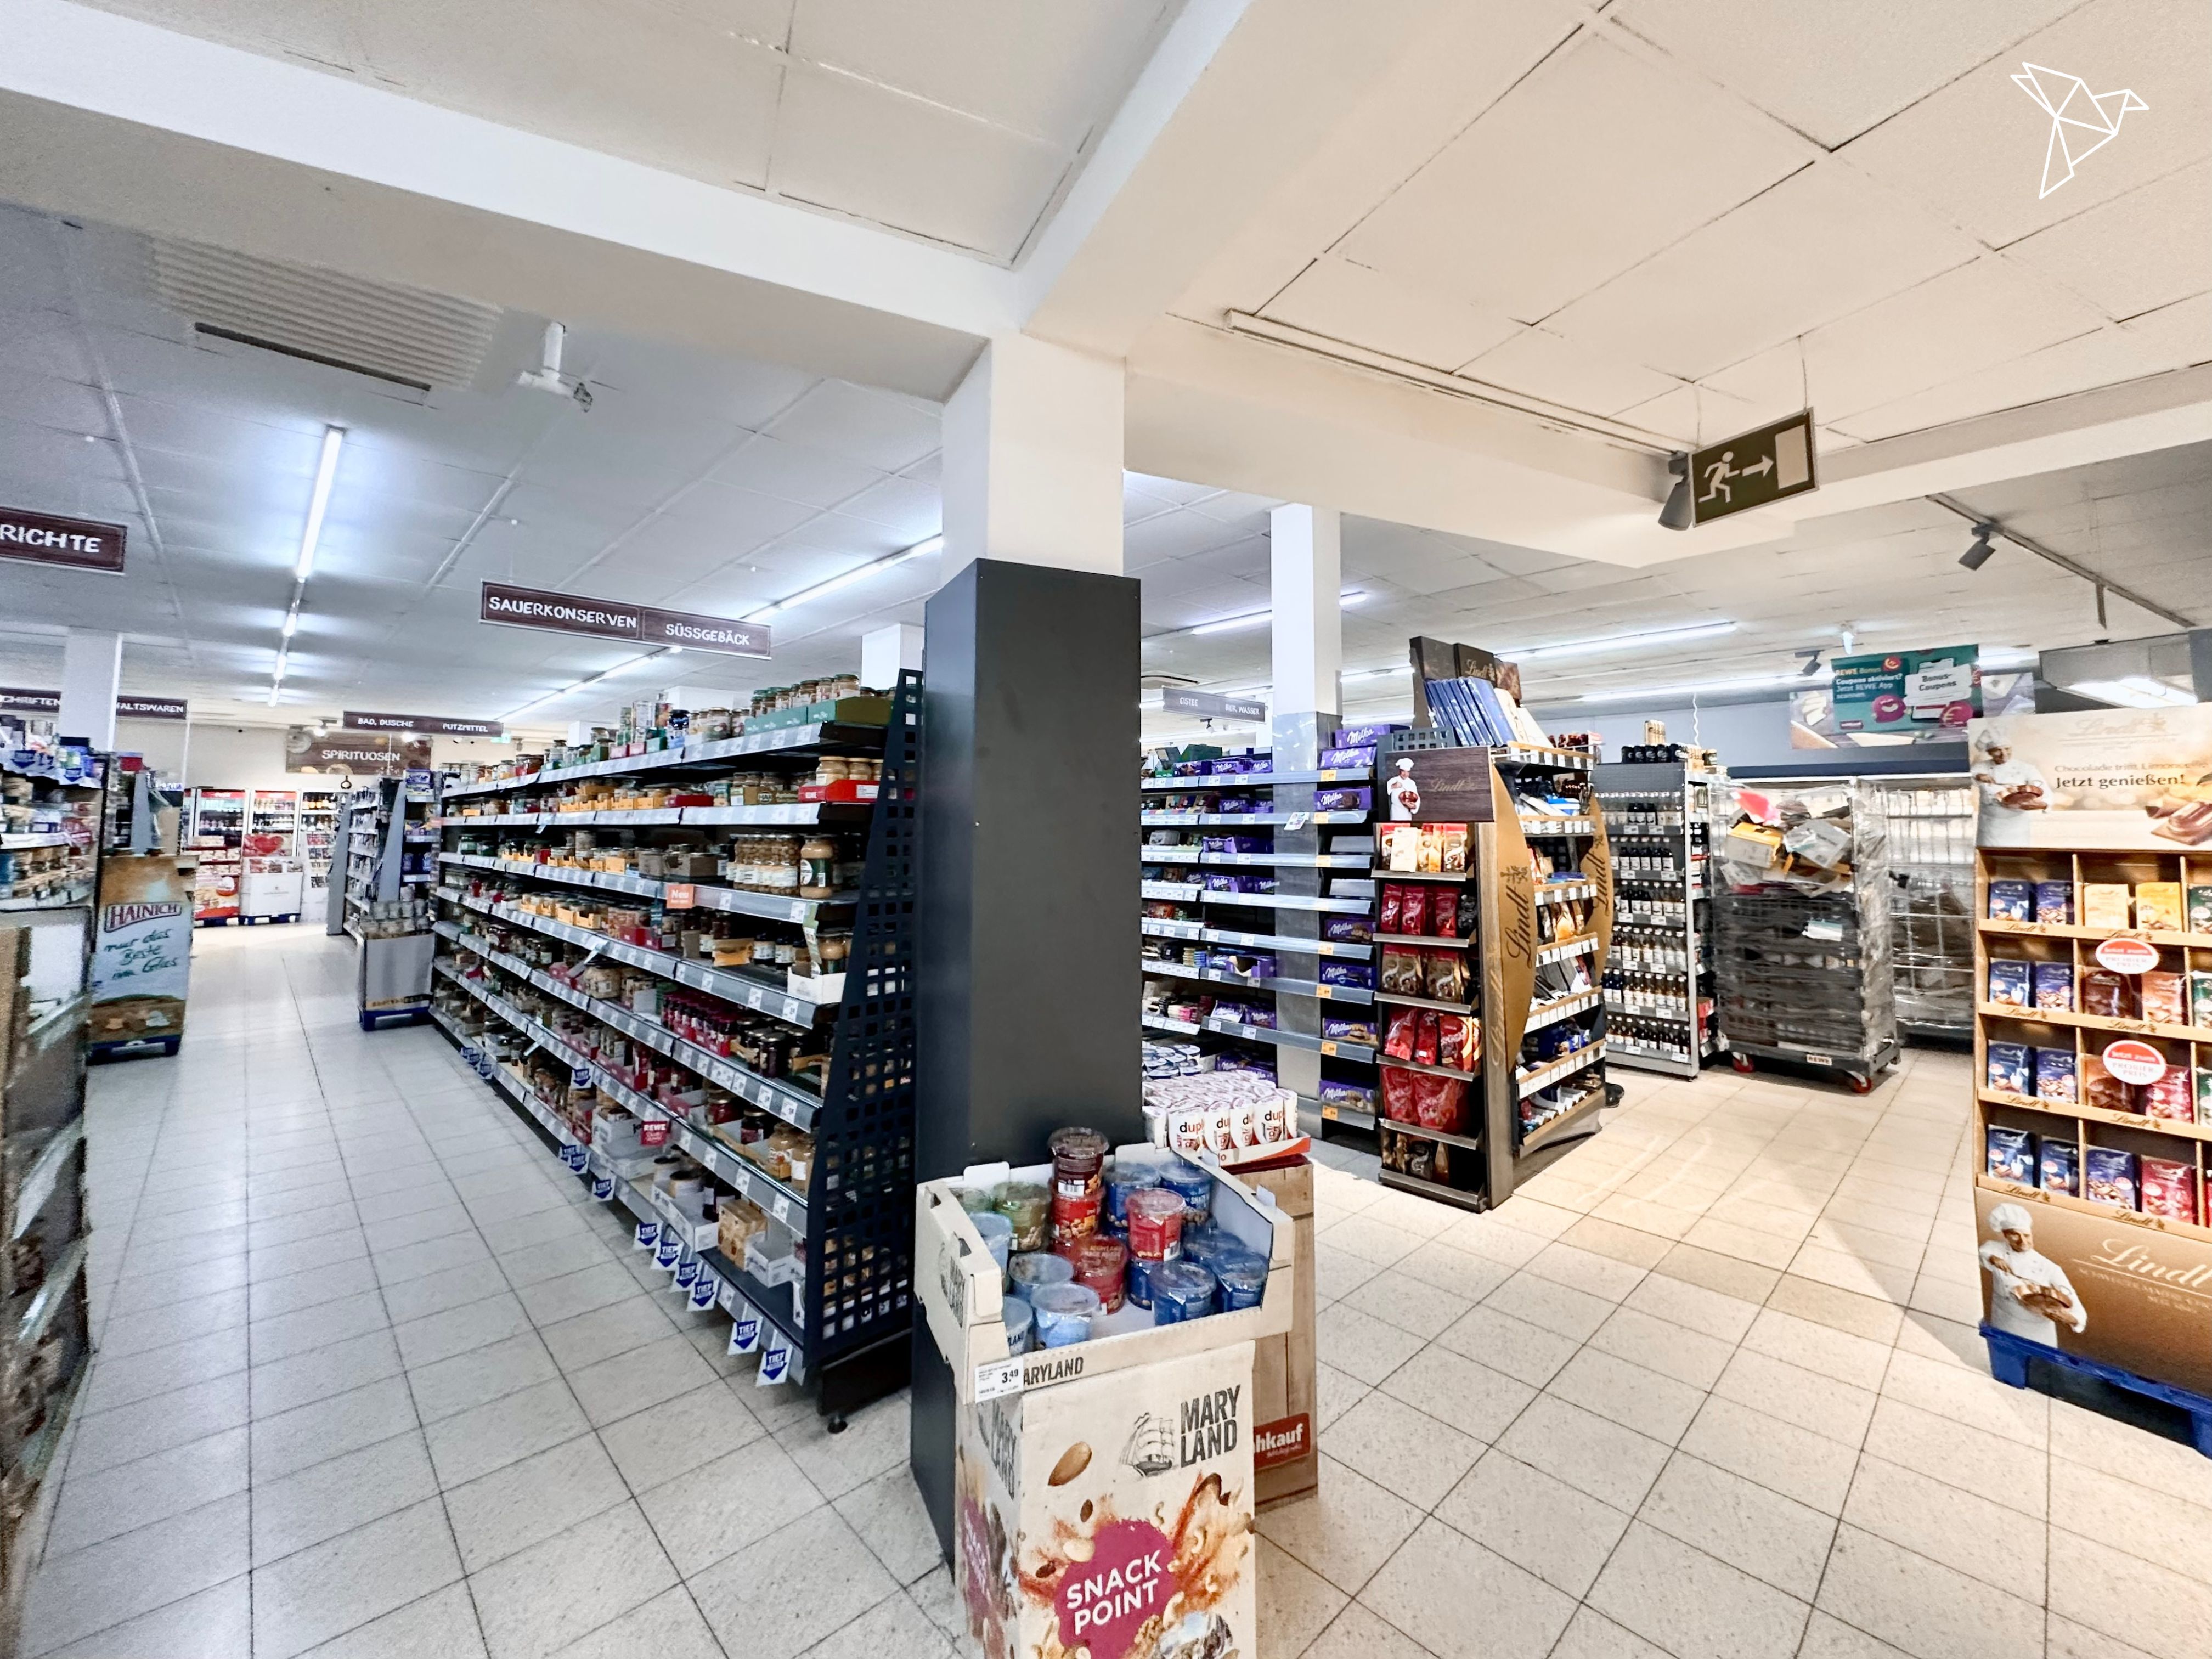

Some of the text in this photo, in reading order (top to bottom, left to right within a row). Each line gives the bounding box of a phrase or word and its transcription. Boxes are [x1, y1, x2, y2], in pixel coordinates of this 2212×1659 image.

[0, 524, 103, 553] RICHTE
[489, 596, 637, 629] SAUERKONSERVEN
[665, 623, 750, 646] SÜSSGEBÄCK
[1922, 673, 1952, 682] Bonus-
[1919, 680, 1957, 691] Coupons
[0, 696, 59, 706] CHRIFTEN
[1180, 697, 1198, 707] EISTEE
[1239, 706, 1260, 715] WASSER
[358, 718, 414, 728] BAD, DUSCHE
[443, 723, 488, 733] PUTZMITTEL
[1347, 727, 1374, 745] Milka
[321, 749, 400, 761] SPIRITUOSEN
[1331, 748, 1360, 764] Milka
[1430, 778, 1466, 792] Lindt
[2056, 774, 2186, 789] Jetzt genießen!
[1321, 792, 1343, 805] Milka
[110, 904, 177, 928] HAINICH
[1330, 923, 1353, 935] Milka
[1505, 885, 1532, 969] Lindt
[1325, 966, 1347, 979] Milka
[1327, 1022, 1354, 1035] Milka
[2111, 1049, 2157, 1063] Jetzt zum
[1323, 1087, 1348, 1099] Milka
[2004, 1094, 2041, 1108] Lindt
[1264, 1110, 1284, 1122] dup
[2111, 1113, 2151, 1126] Lindt
[644, 1124, 667, 1132] REWE
[2005, 1183, 2041, 1199] Lindt
[2112, 1209, 2153, 1226] Lindt
[641, 1225, 656, 1234] TIEF
[681, 1265, 696, 1274] TIEF
[697, 1283, 712, 1293] TIEF
[738, 1322, 755, 1334] TIEF
[768, 1351, 785, 1363] TIEF
[1001, 1369, 1019, 1384] 3.49
[1023, 1356, 1084, 1386] ARYLAND
[1181, 1384, 1241, 1435] MARY
[1181, 1419, 1238, 1468] LAND
[1254, 1423, 1304, 1453] hkauf
[1066, 1549, 1162, 1609] SNACK
[1074, 1578, 1159, 1636] POINT
